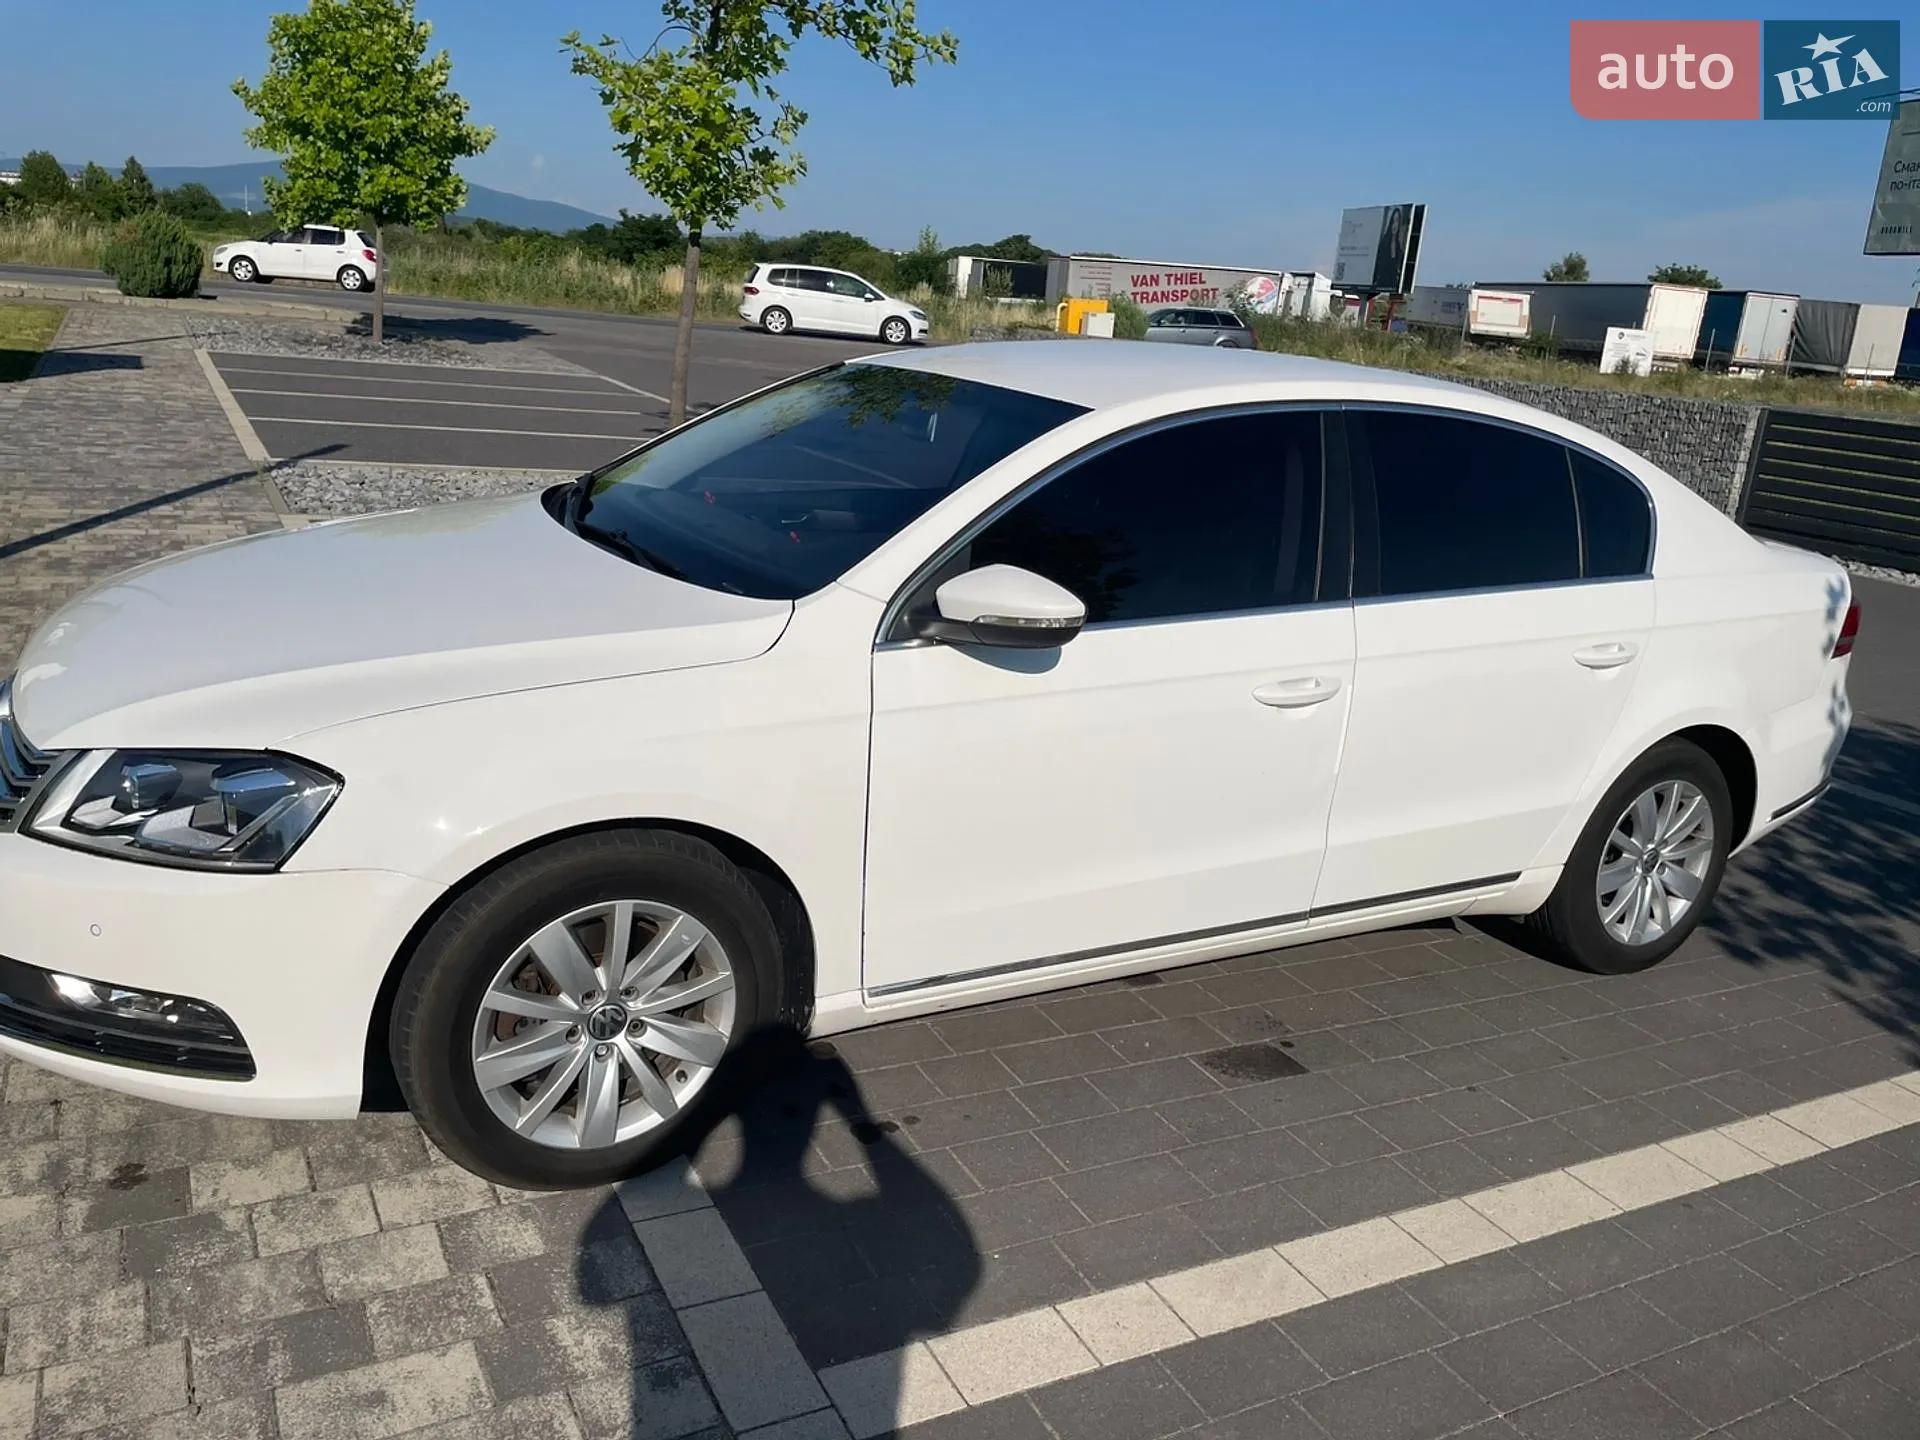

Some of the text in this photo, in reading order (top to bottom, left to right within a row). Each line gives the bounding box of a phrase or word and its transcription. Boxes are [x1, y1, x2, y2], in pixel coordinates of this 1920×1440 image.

[1130, 271, 1207, 288] VAN THIEL
[1130, 287, 1220, 305] TRANSPORT
